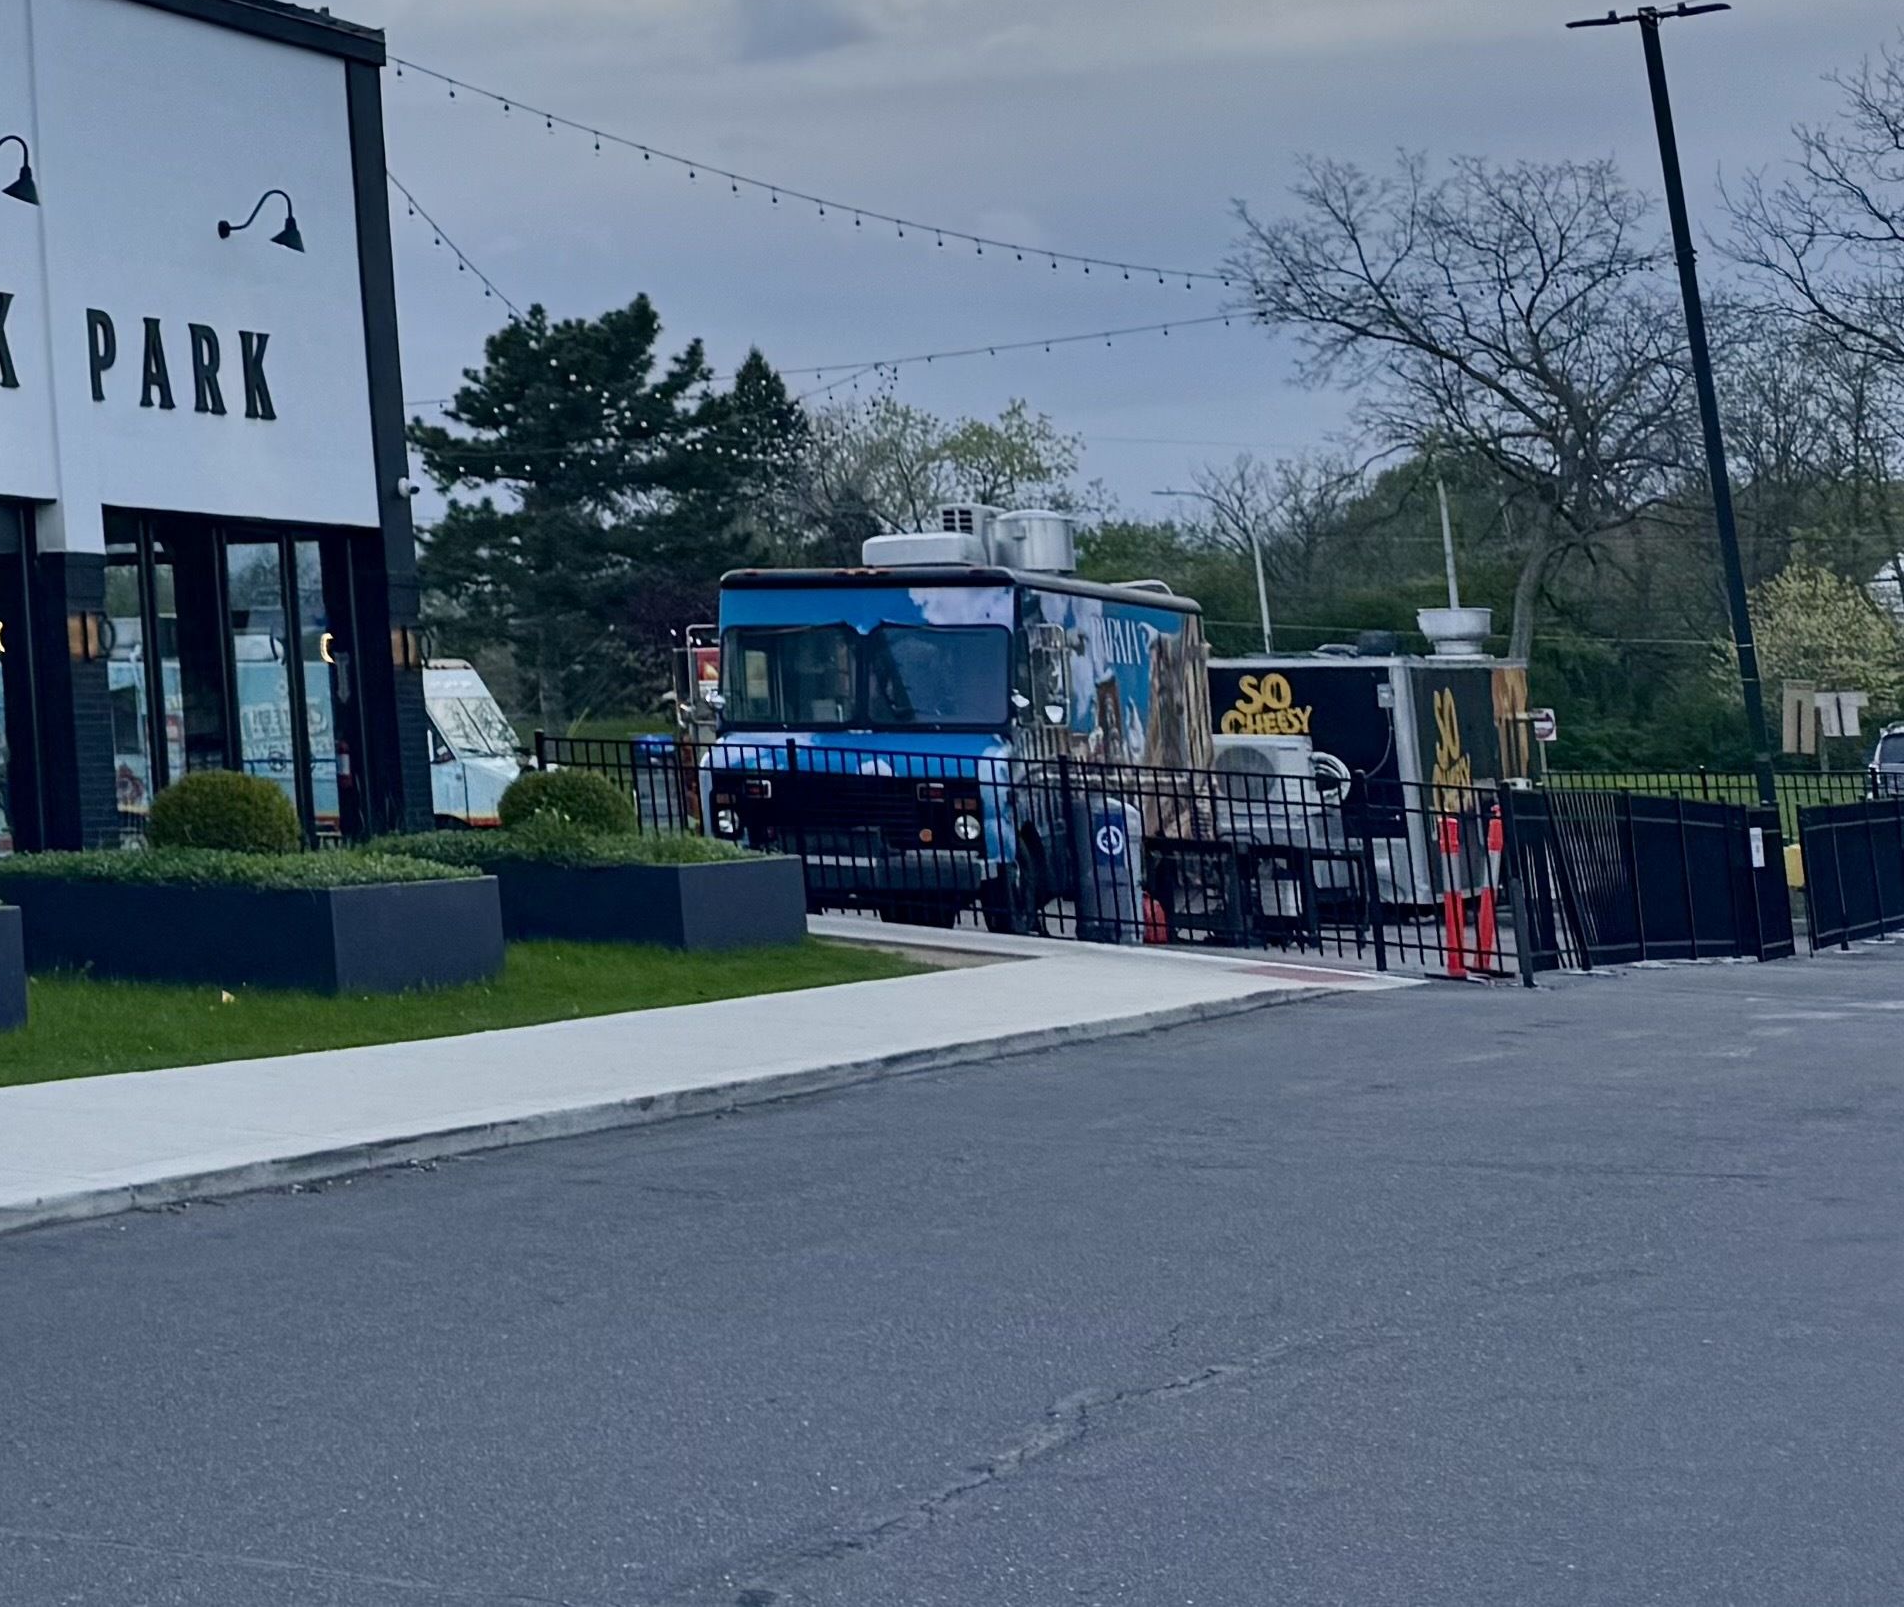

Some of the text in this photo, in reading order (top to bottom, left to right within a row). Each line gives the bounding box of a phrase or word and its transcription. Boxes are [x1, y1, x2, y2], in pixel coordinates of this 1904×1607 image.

[86, 308, 276, 420] PARK
[1235, 673, 1292, 713] SO
[1221, 705, 1312, 734] CHEESY
